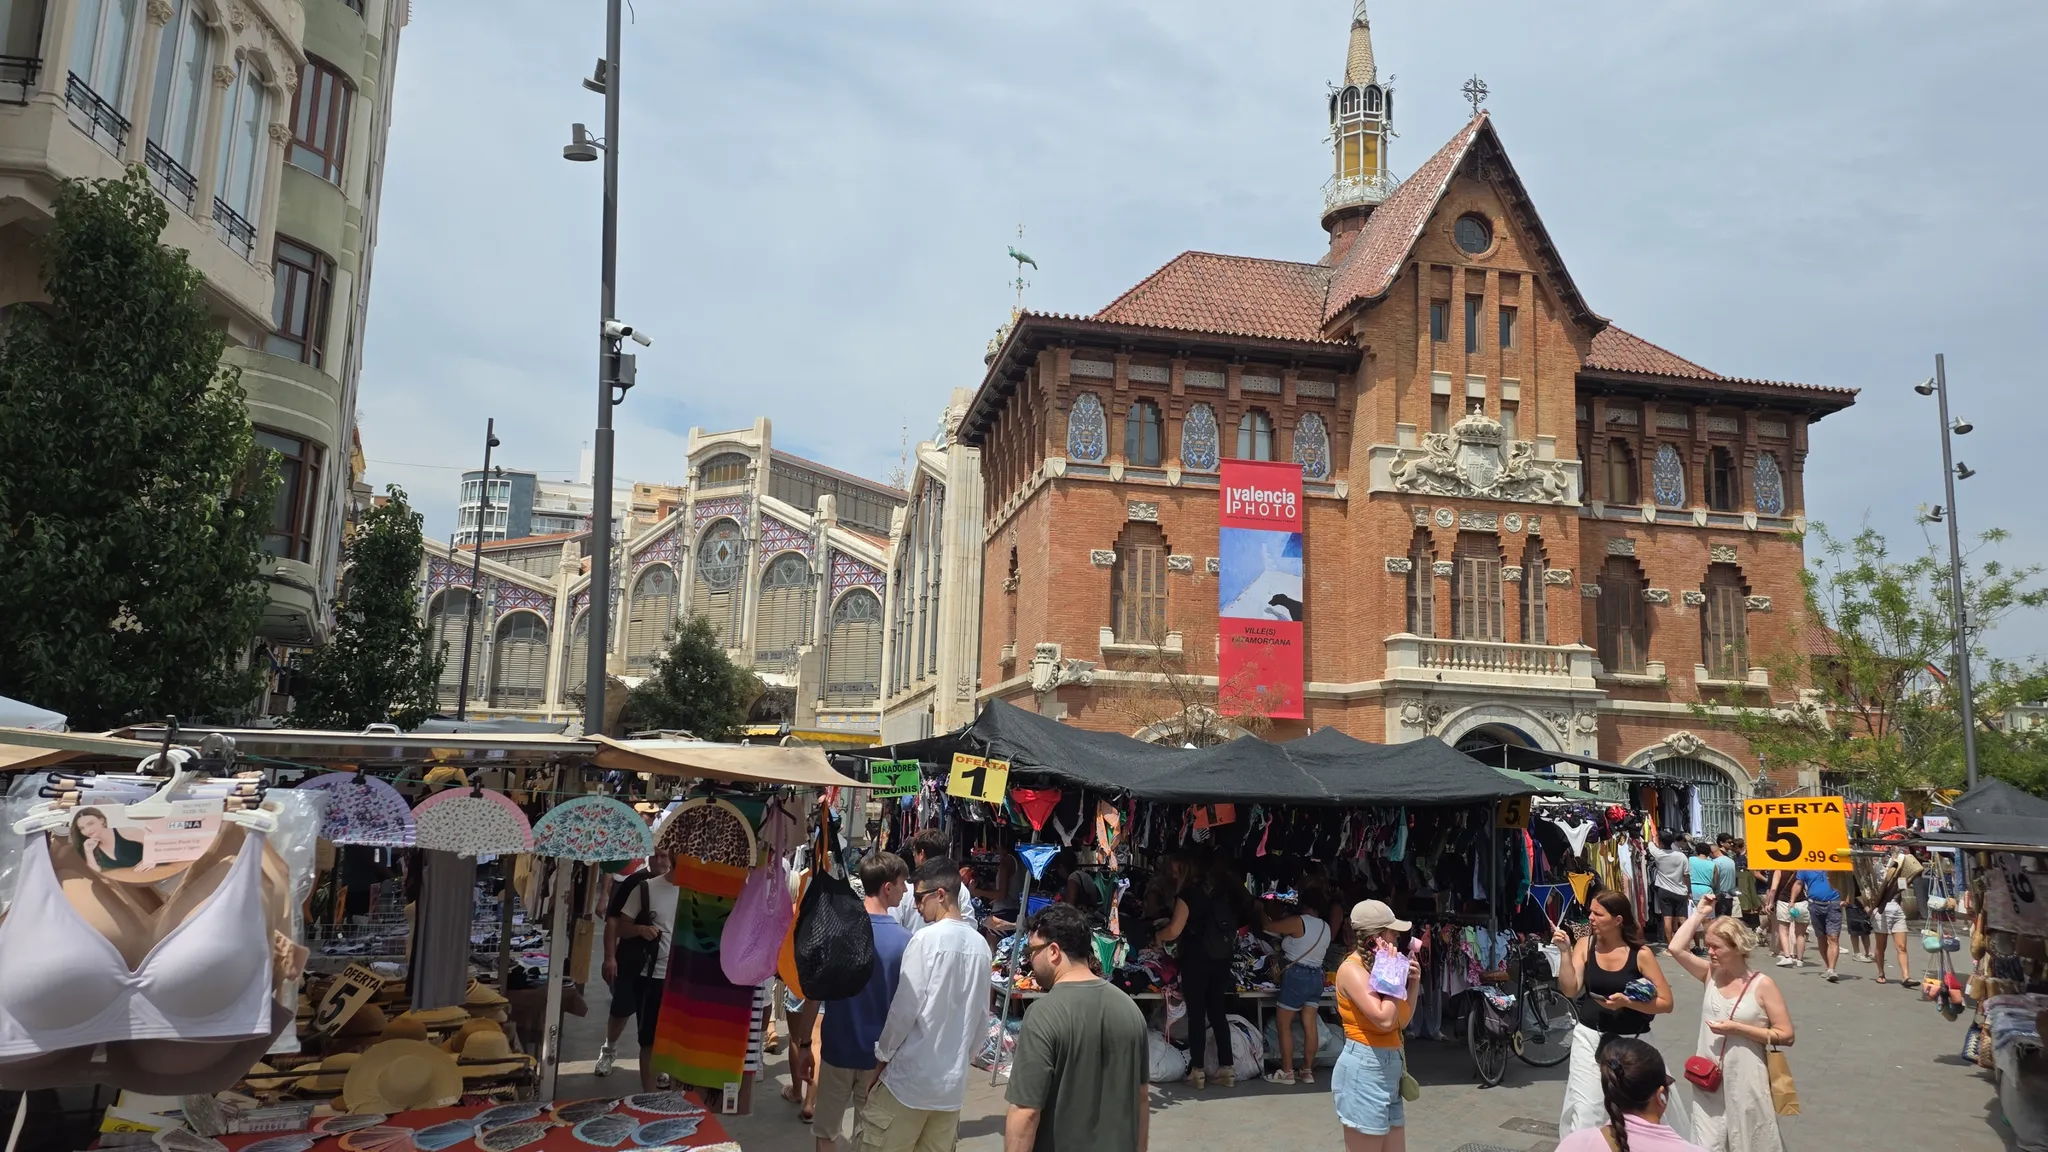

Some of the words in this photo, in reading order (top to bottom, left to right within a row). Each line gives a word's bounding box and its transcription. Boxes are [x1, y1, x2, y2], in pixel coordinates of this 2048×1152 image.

[1232, 486, 1295, 504] valencia
[1232, 501, 1296, 518] PHOTO
[1244, 626, 1276, 637] VILLE(S)
[1231, 636, 1291, 646] TAMORGANA
[872, 763, 917, 774] BAÑADORES
[955, 755, 1008, 771] OFERTA
[885, 773, 901, 786] Y
[961, 766, 987, 797] 1
[872, 785, 918, 795] BIQUINIS
[1747, 802, 1840, 815] OFERTA
[169, 821, 200, 829] HANA
[343, 967, 381, 991] OFERTA
[318, 982, 360, 1026] 5
